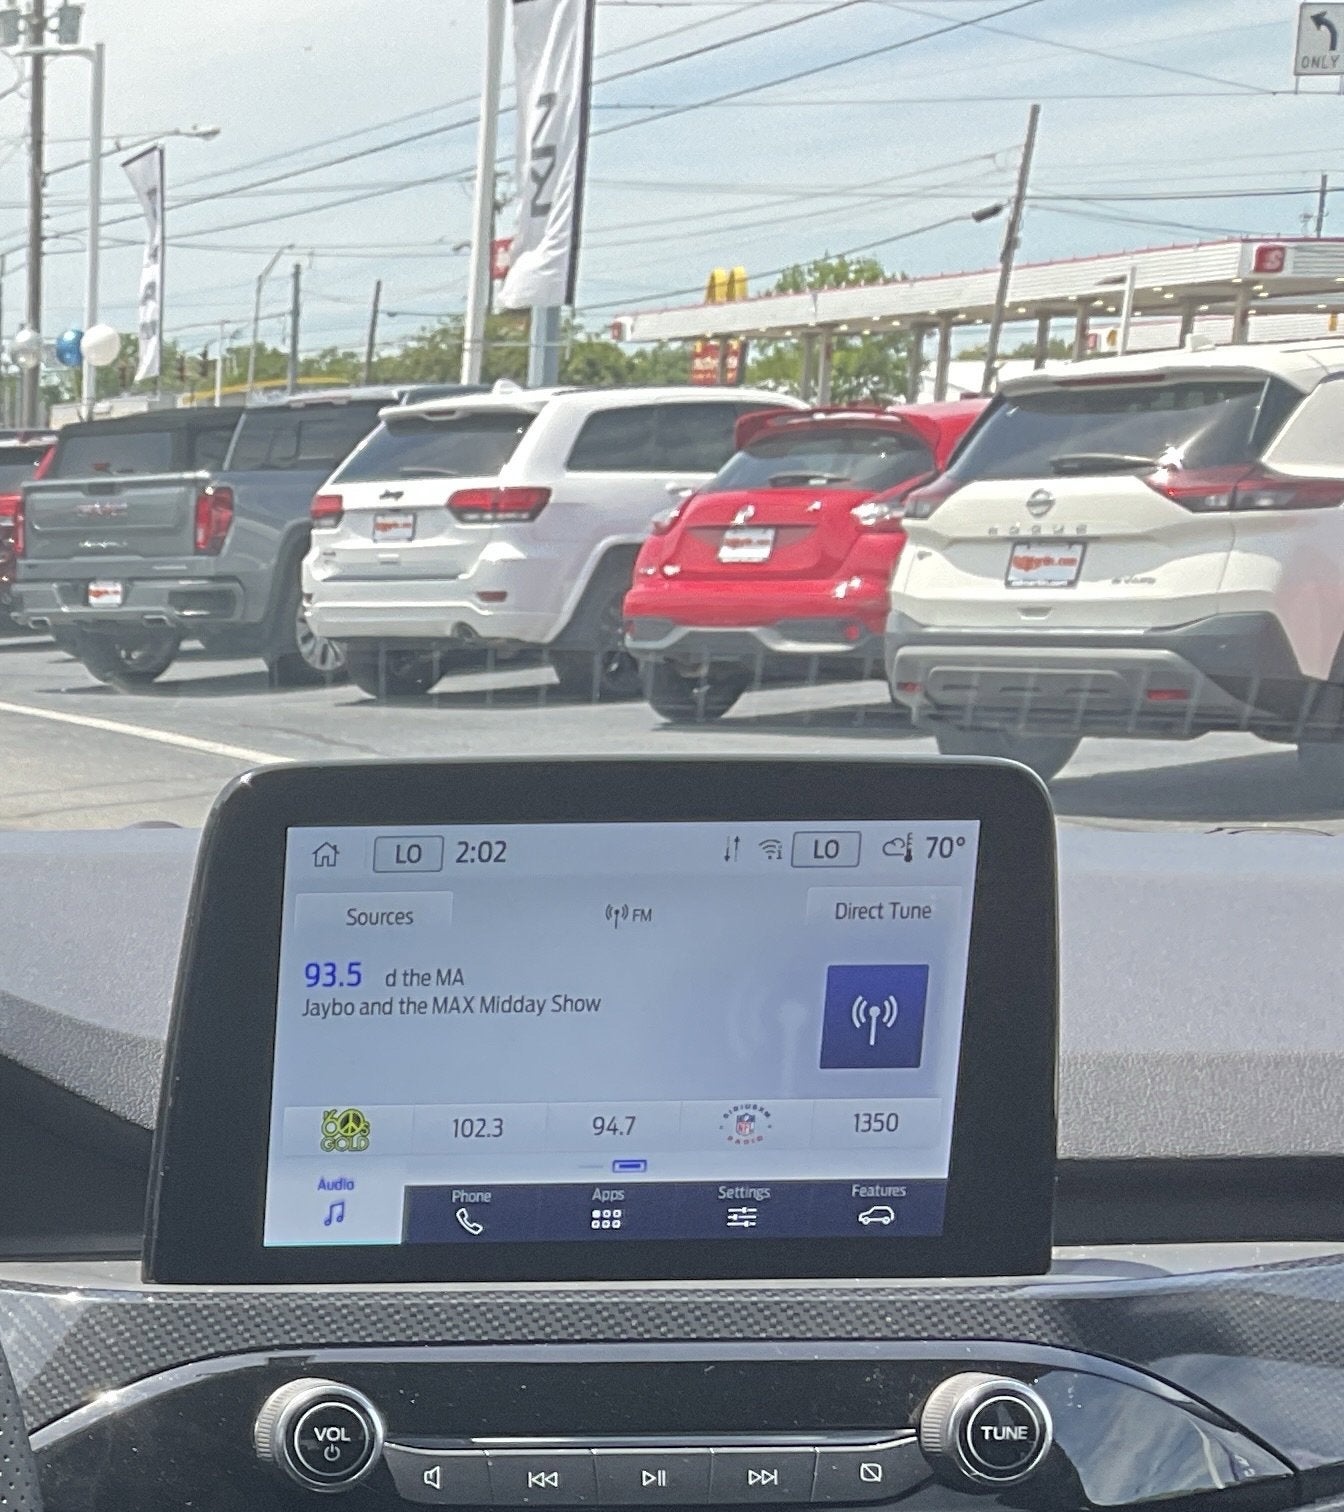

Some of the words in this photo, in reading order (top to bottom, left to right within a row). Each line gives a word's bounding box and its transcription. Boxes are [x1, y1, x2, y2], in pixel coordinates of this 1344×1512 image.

[1301, 55, 1340, 69] ONLY
[395, 844, 421, 864] LO
[455, 840, 507, 864] 2:02
[813, 839, 839, 859] LO
[926, 835, 966, 859] 70°
[346, 908, 414, 926] Sources
[632, 907, 652, 923] FM
[834, 902, 886, 919] Direct
[890, 901, 932, 920] Tune
[304, 961, 363, 988] 93.5
[385, 967, 397, 986] d
[401, 967, 430, 986] the
[434, 969, 464, 986] MA
[303, 997, 354, 1018] Jaybo
[358, 996, 393, 1015] and
[396, 996, 426, 1014] the
[431, 997, 475, 1014] MAX
[479, 995, 546, 1018] Midday
[551, 995, 601, 1013] Show
[453, 1119, 503, 1138] 102.3
[592, 1116, 636, 1136] 94.7
[853, 1114, 899, 1133] 1350
[320, 1136, 370, 1152] GOLD
[318, 1177, 355, 1192] Audio
[718, 1185, 771, 1202] Settings
[851, 1183, 907, 1199] Features
[452, 1189, 491, 1203] Phone
[592, 1187, 625, 1203] Apps
[313, 1427, 351, 1441] VOL
[981, 1425, 1027, 1441] TUNE
